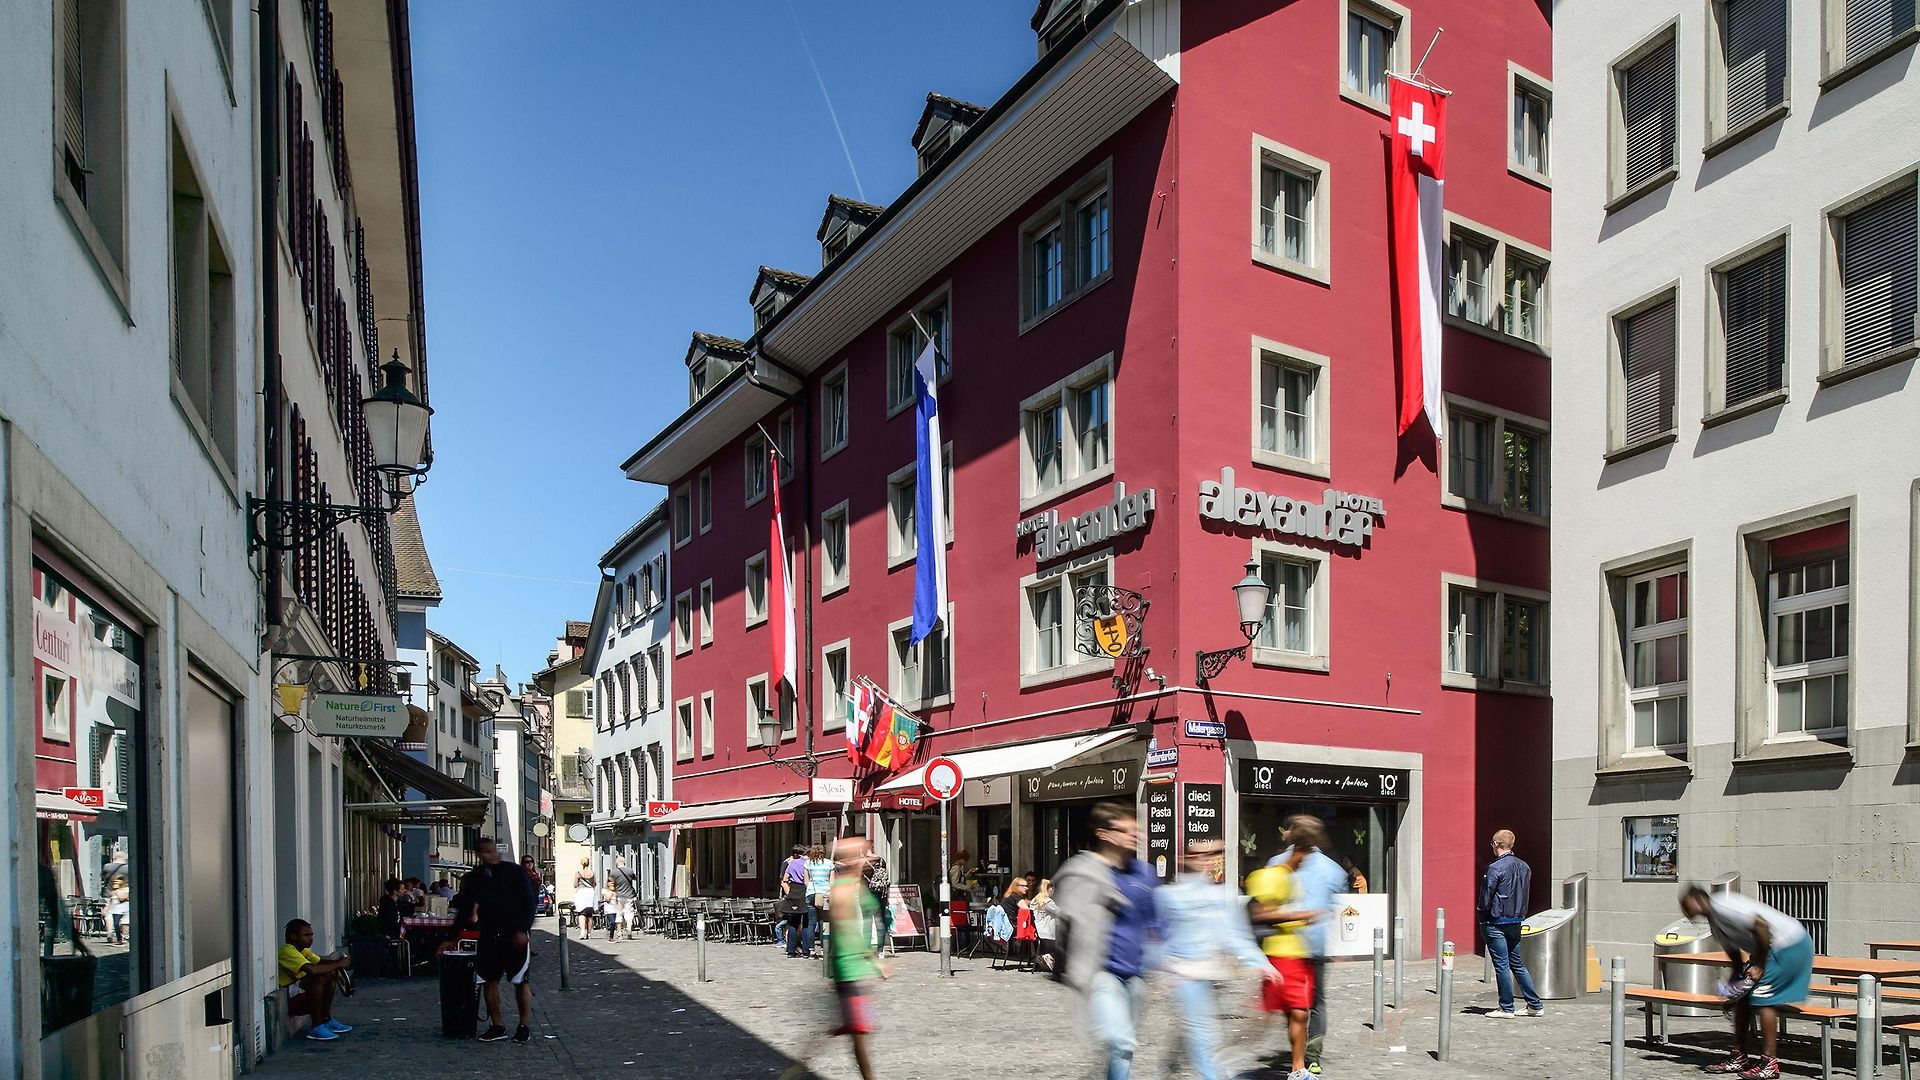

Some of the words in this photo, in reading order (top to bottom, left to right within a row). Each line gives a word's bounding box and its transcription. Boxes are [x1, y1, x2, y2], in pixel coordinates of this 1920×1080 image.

[1199, 466, 1373, 546] alexander
[1335, 490, 1387, 516] HOTEL
[1016, 511, 1049, 538] HOTEL
[1035, 481, 1156, 563] alexander
[326, 700, 359, 711] Nature
[374, 703, 396, 712] First
[336, 714, 386, 723] Naturheilmittel
[336, 722, 386, 731] Naturkosmetik
[1188, 722, 1224, 737] Malergasse
[1254, 782, 1272, 790] dieci
[898, 797, 922, 806] HOTEL
[1150, 790, 1167, 803] dieci
[1188, 789, 1211, 802] dieci
[1150, 806, 1172, 818] Pasta
[1188, 805, 1215, 818] Pizza
[1150, 821, 1166, 833] take
[1188, 820, 1209, 833] take
[1150, 838, 1169, 851] away
